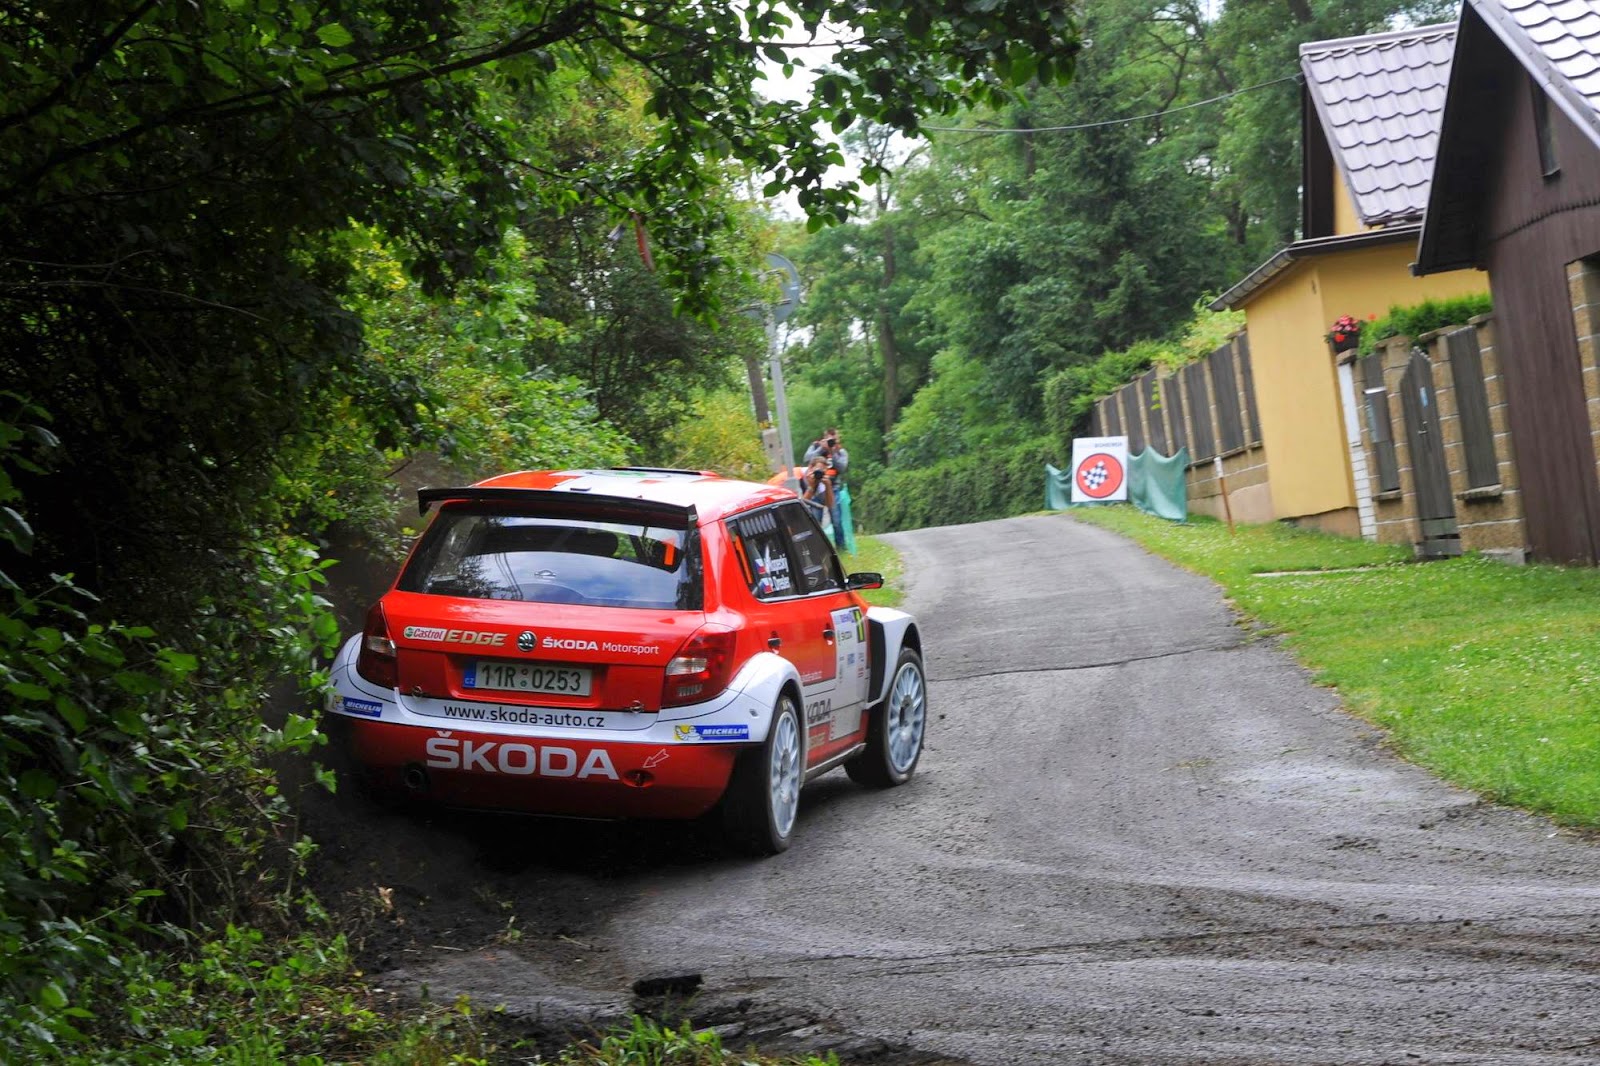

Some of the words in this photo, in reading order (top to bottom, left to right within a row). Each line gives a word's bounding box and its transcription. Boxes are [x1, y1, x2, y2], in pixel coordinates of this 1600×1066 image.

[413, 628, 444, 640] Castrol
[445, 629, 509, 646] EDGE
[542, 636, 598, 651] ŠKODA
[602, 642, 659, 655] Motorsport
[482, 664, 515, 688] 11R
[532, 668, 581, 692] 0253
[346, 701, 382, 712] MICHELIN
[444, 705, 605, 728] www.skoda-auto.cz
[425, 730, 620, 781] ŠKODA
